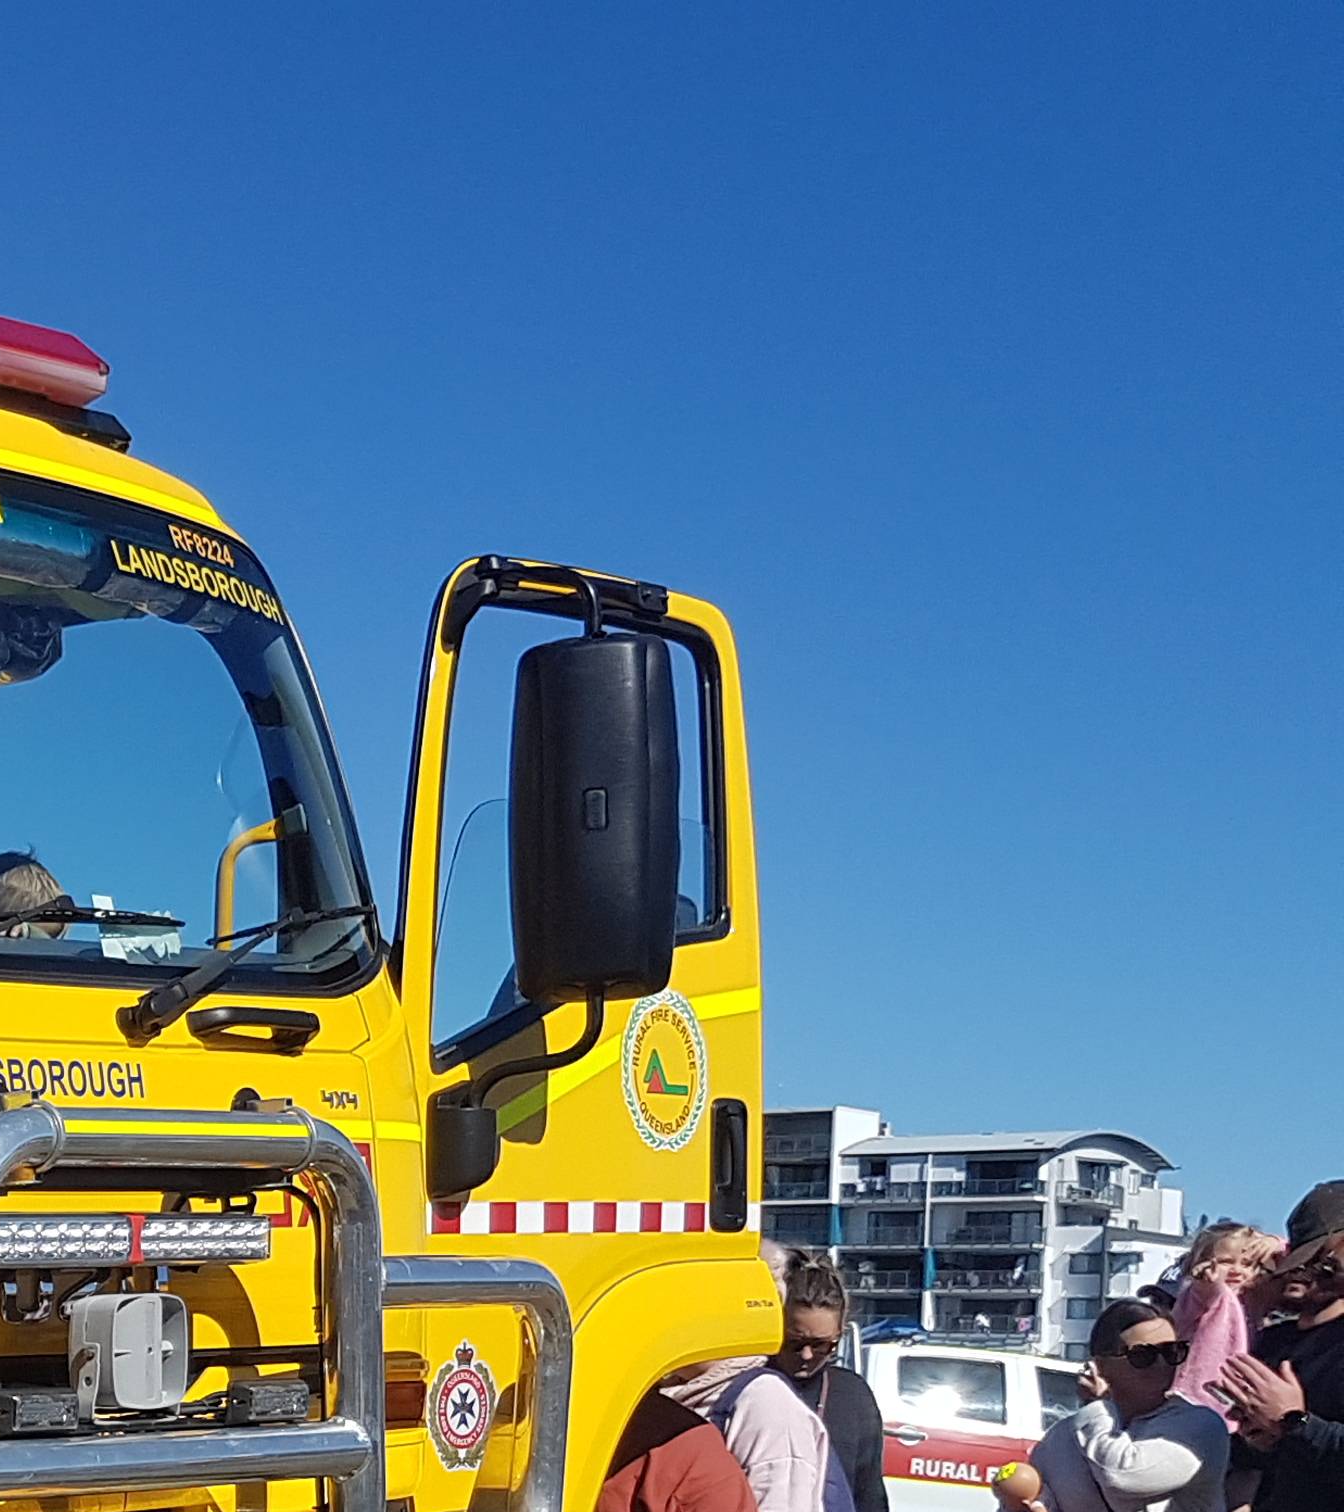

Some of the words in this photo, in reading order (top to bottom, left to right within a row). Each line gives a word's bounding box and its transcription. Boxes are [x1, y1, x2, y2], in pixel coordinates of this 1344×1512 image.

[168, 524, 235, 568] RF8224
[111, 540, 284, 626] LANDSBOROUGH
[632, 1024, 651, 1066] RURAL
[650, 1009, 670, 1025] FIRE
[670, 1013, 696, 1070] SERVICE
[640, 1102, 690, 1135] QUEENSLAND
[910, 1458, 983, 1482] RURAL
